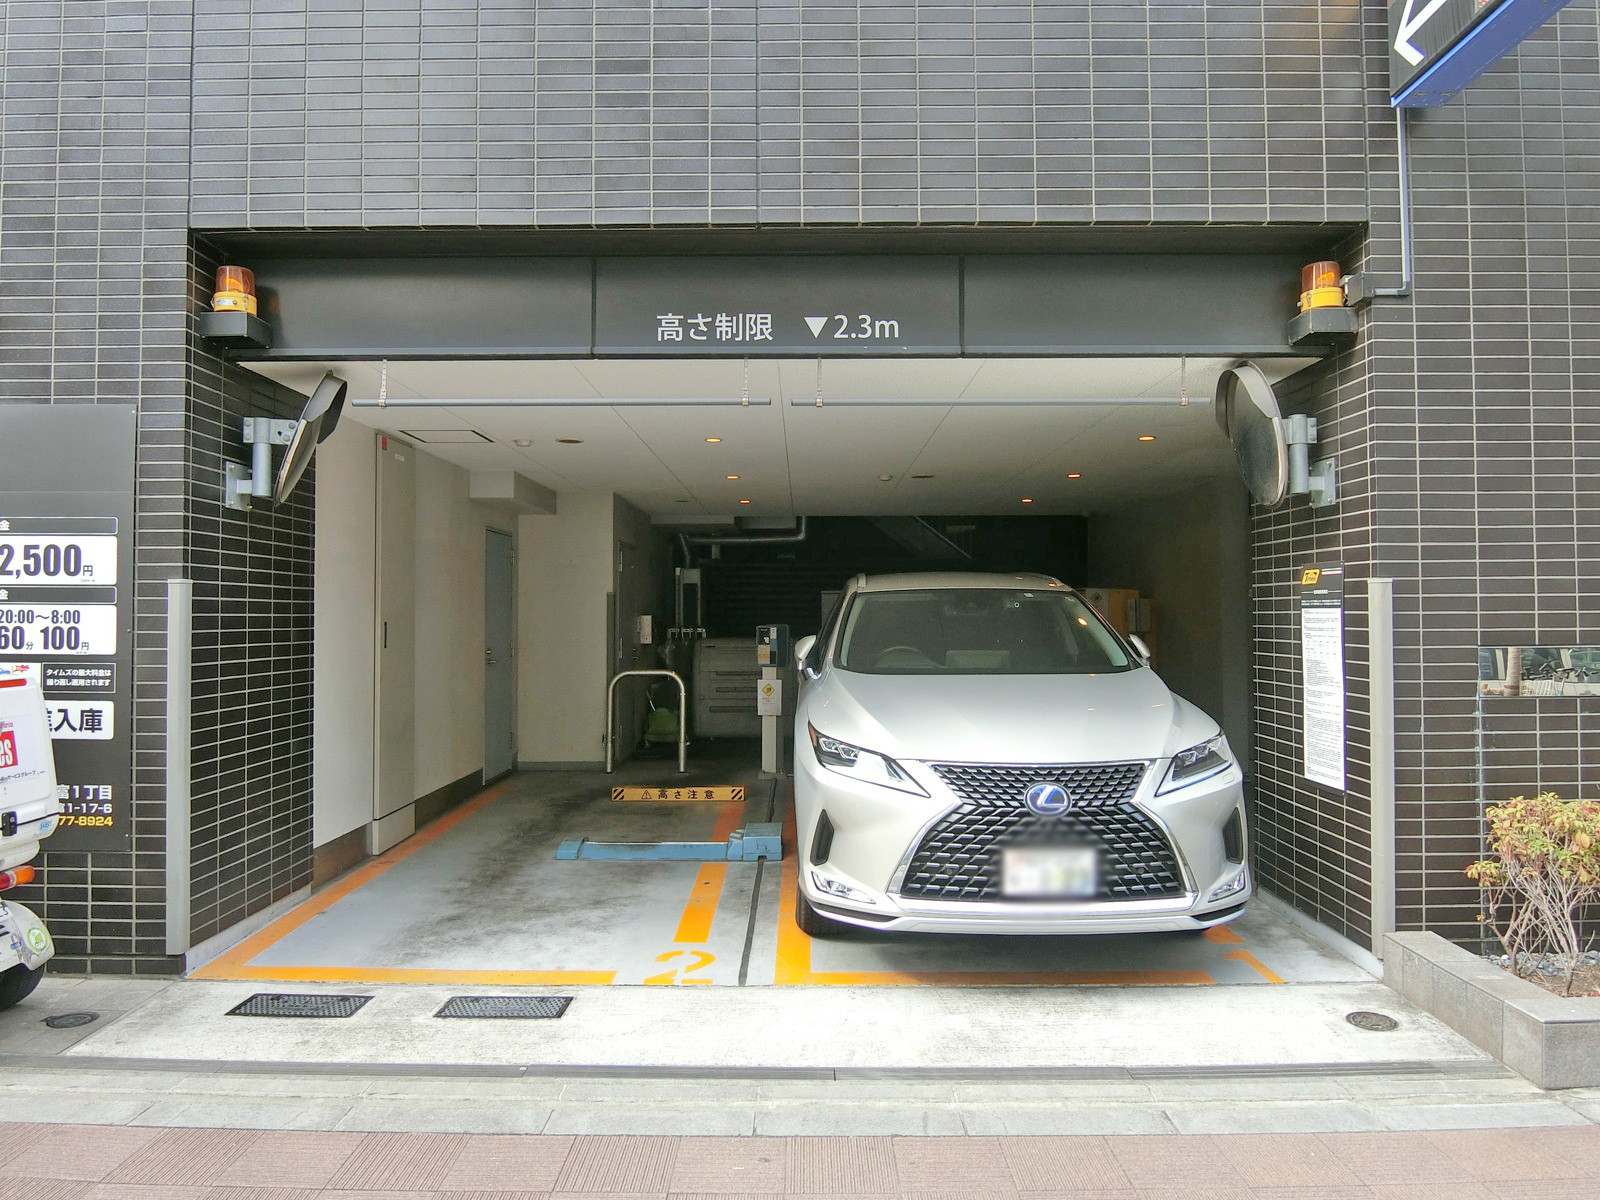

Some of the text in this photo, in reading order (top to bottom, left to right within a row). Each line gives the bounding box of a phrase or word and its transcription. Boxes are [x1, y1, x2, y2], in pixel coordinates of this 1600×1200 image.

[656, 313, 899, 342] 高さ制限 2.3m
[658, 789, 714, 799] 高さ注意
[643, 949, 716, 985] 2
